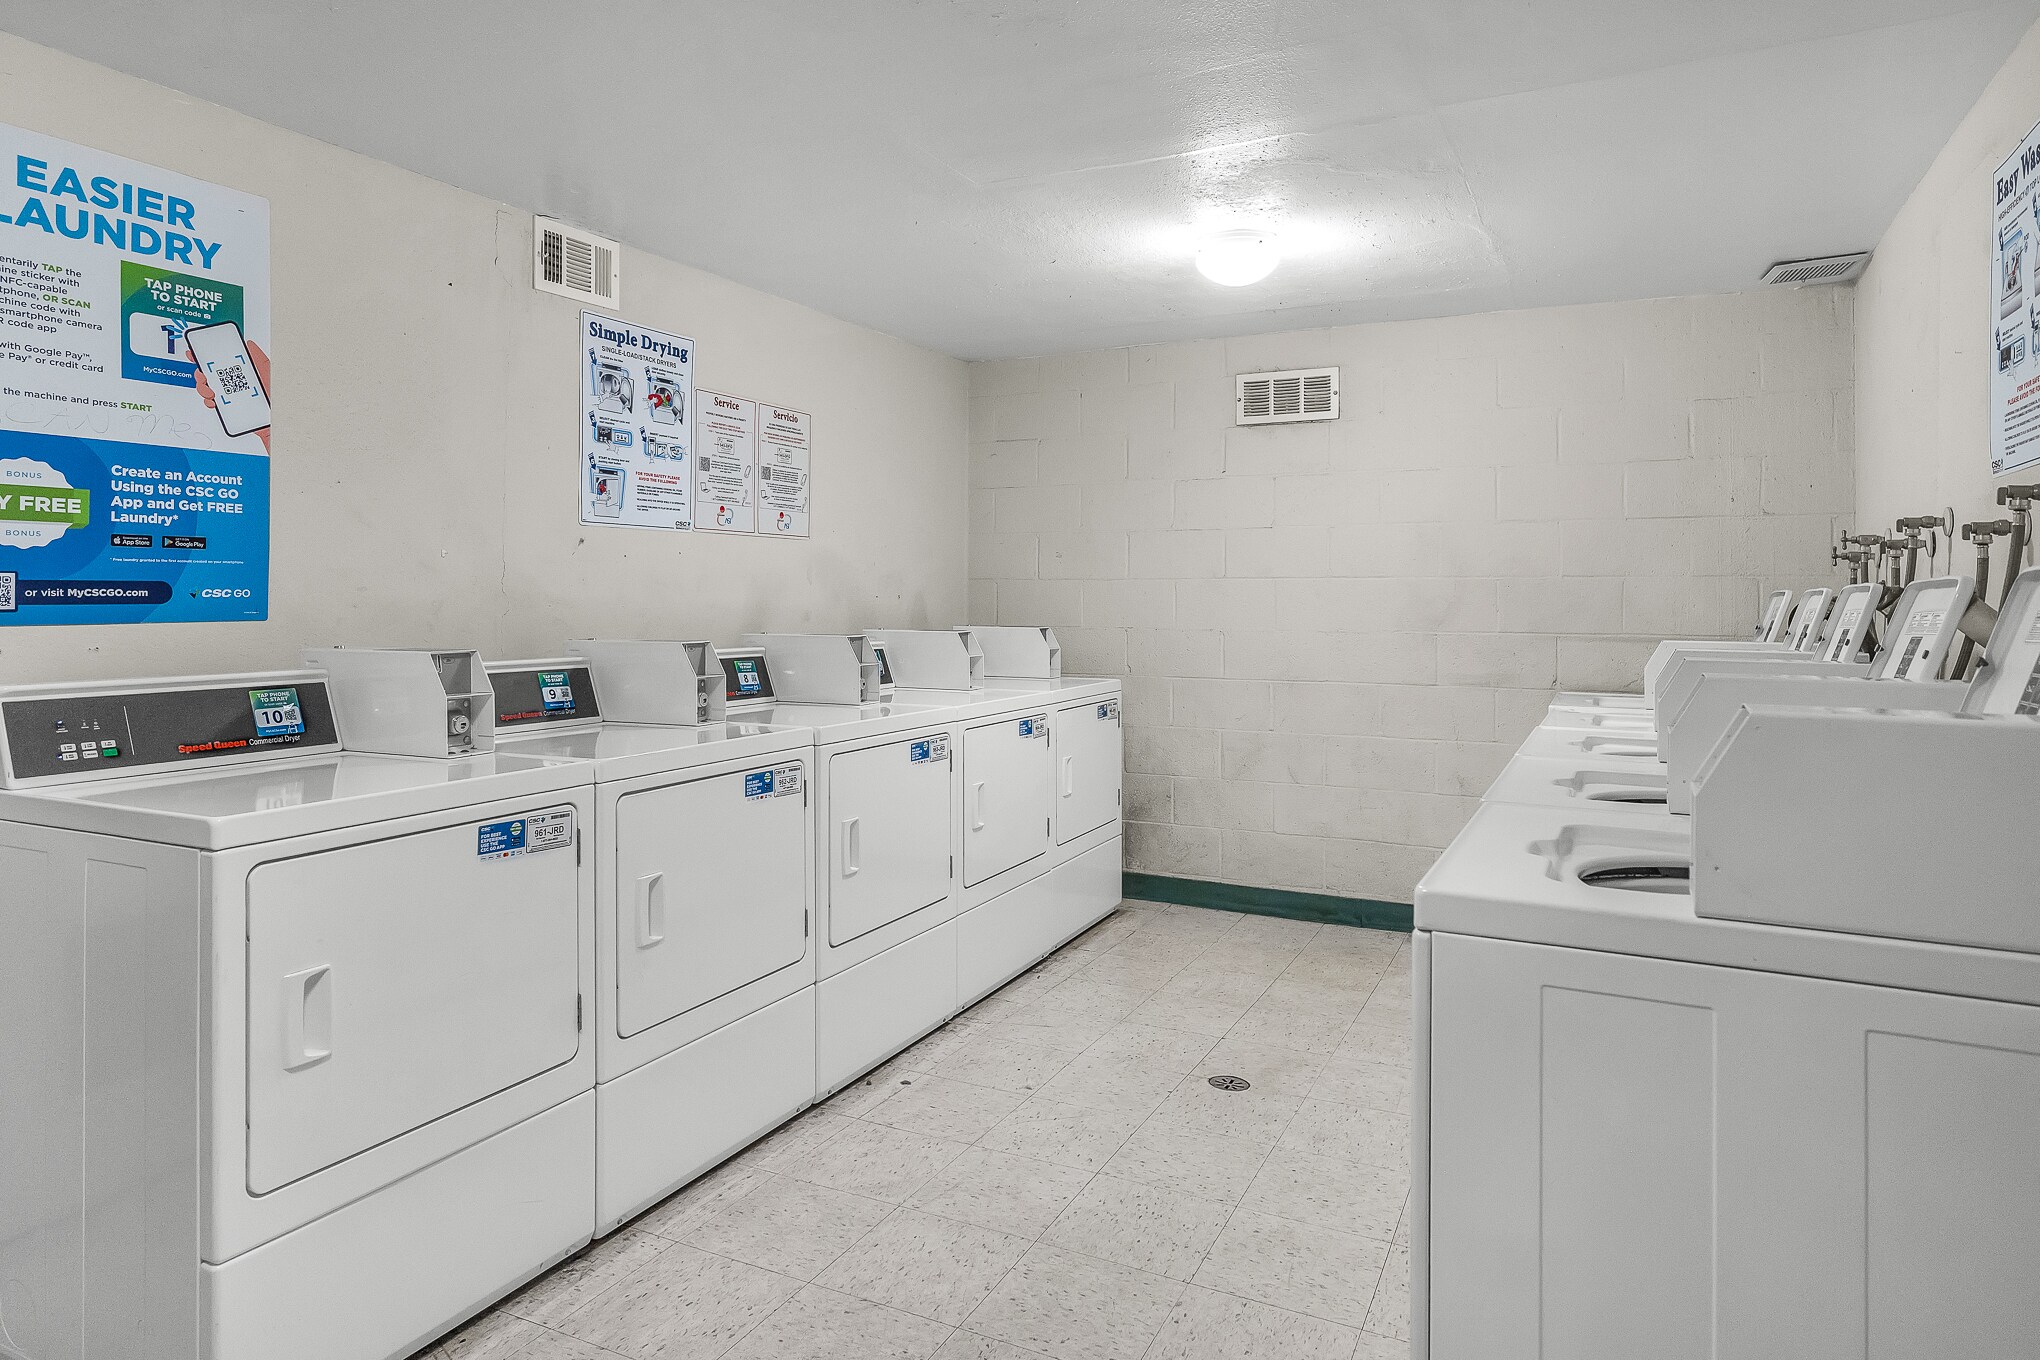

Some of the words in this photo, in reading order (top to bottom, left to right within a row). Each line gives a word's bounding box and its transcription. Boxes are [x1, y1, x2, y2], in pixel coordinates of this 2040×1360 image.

[17, 155, 195, 230] EASIER
[1996, 167, 2019, 206] Easy
[42, 263, 63, 273] TAP
[66, 268, 82, 278] the
[0, 276, 68, 295] NFC-capable
[21, 270, 55, 282] sticker
[58, 278, 80, 288] with
[144, 277, 172, 291] TAP
[175, 283, 223, 303] PHONE
[43, 294, 59, 303] OR
[61, 298, 91, 309] SCAN
[150, 290, 170, 303] TO
[173, 295, 217, 312] START
[31, 303, 56, 313] code
[59, 308, 81, 317] with
[167, 307, 183, 315] scan
[184, 310, 202, 318] code
[0, 308, 63, 324] smartphone
[66, 320, 103, 331] camera
[7, 319, 34, 329] code
[37, 324, 57, 334] app
[589, 321, 638, 348] Simple
[641, 334, 688, 363] Drying
[24, 344, 62, 358] Google
[35, 357, 47, 365] or
[49, 359, 79, 370] credit
[82, 364, 104, 373] card
[657, 358, 677, 369] DRYERS
[143, 366, 192, 379] MyCSCGO.com
[3, 387, 21, 396] the
[24, 389, 68, 402] machine
[70, 396, 89, 405] and
[92, 399, 118, 409] press
[120, 401, 153, 412] START
[714, 396, 740, 411] Service
[773, 409, 799, 423] Servicio
[6, 470, 42, 479] BONUS
[111, 465, 161, 479] Create
[165, 471, 182, 481] an
[186, 471, 243, 486] Account
[111, 480, 154, 496] Using
[157, 484, 182, 496] the
[185, 486, 214, 498] CSC
[217, 489, 239, 499] GO
[19, 495, 82, 514] FREE
[110, 496, 143, 510] App
[147, 499, 175, 510] and
[178, 500, 203, 512] Get
[207, 502, 243, 514] FREE
[5, 529, 42, 537] BONUS
[25, 588, 38, 597] or
[40, 587, 64, 597] visit
[67, 588, 149, 599] MyCSCGO.com
[201, 588, 231, 598] CSC
[233, 588, 251, 598] GO
[743, 674, 749, 683] 8
[548, 689, 556, 699] 9
[262, 710, 283, 724] 10
[178, 742, 212, 754] Speed
[214, 738, 247, 749] Queen
[249, 736, 284, 746] Commercial
[284, 734, 301, 743] Dryer
[534, 825, 564, 837] 961-JRD
